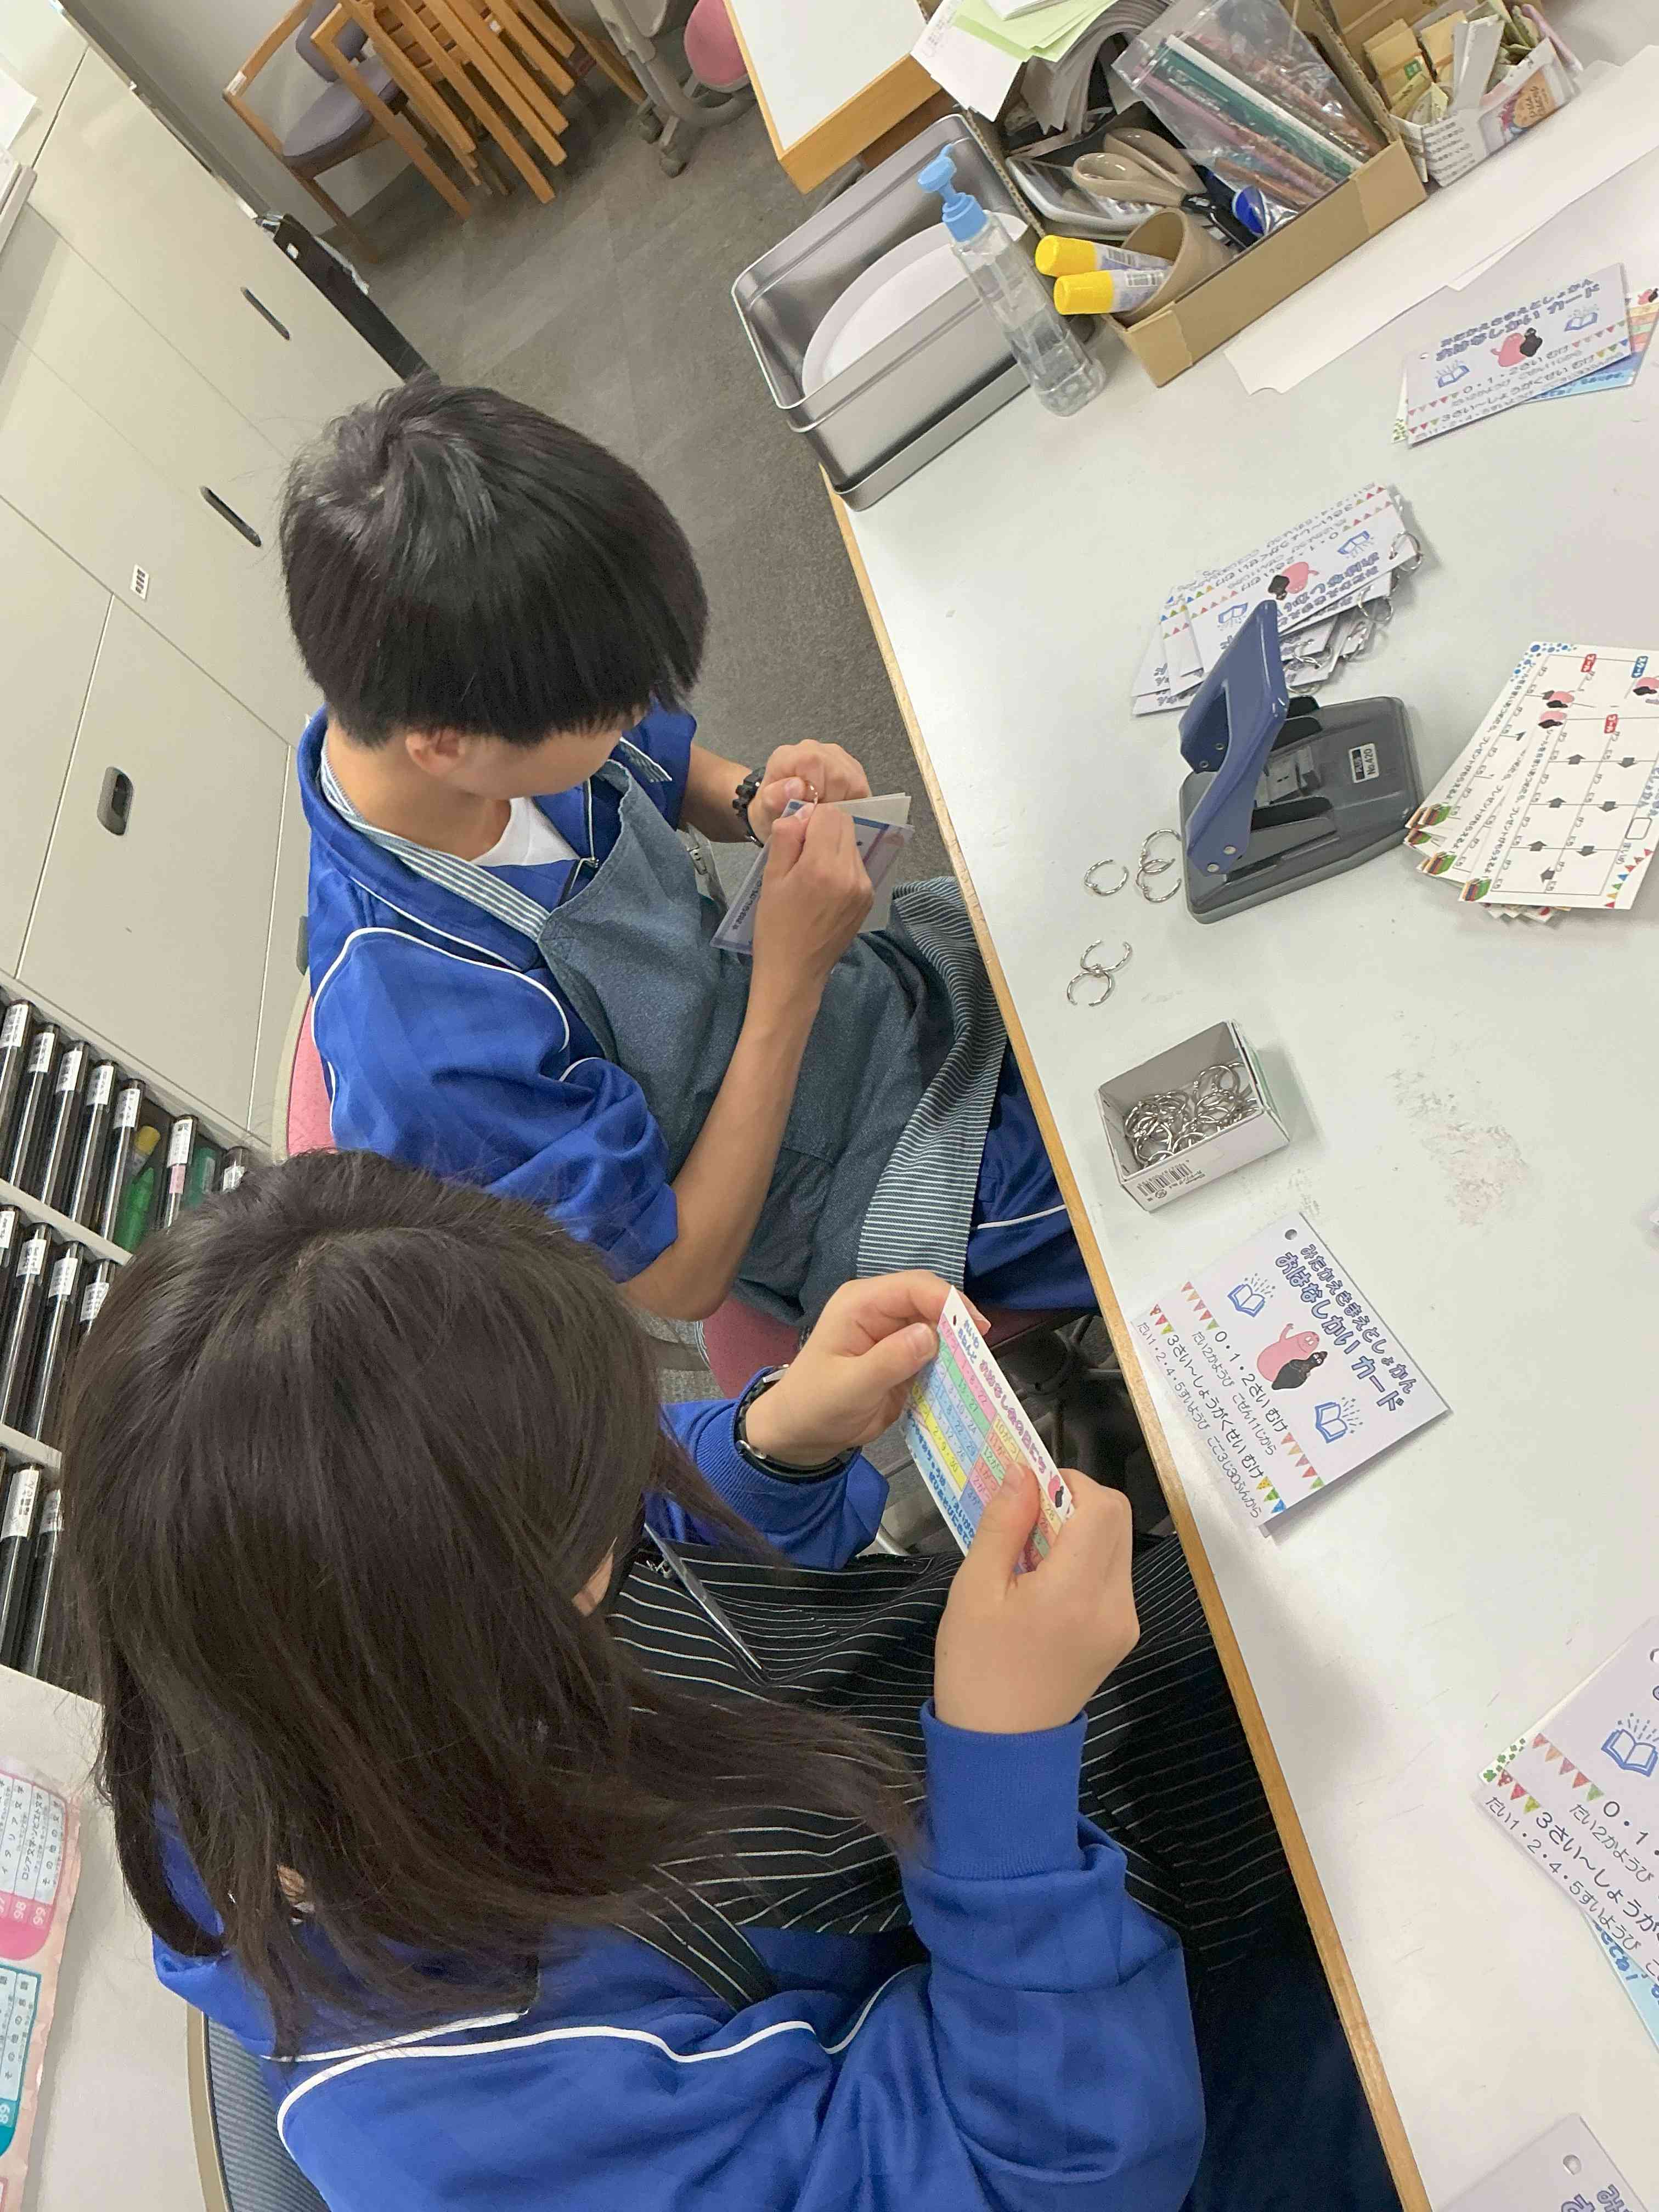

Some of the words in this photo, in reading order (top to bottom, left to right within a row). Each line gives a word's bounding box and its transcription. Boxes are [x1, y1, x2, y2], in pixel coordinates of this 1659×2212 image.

[1548, 284, 1601, 315] カード
[1364, 748, 1376, 775] No.420
[1275, 1252, 1359, 1355] おはなしかい
[1351, 1356, 1404, 1413] カード
[1300, 1244, 1418, 1394] みたかえきまえとしょかん
[1137, 1322, 1210, 1431] だい1・2・4・5すいようび
[1206, 1435, 1262, 1519] ごご3じ30ふんから
[1166, 1334, 1248, 1453] 3さい～しょうがくせい
[1241, 1453, 1264, 1479] むけ
[1192, 1330, 1234, 1387] だい2かようび
[1232, 1391, 1276, 1457] ごぜん11じから
[1214, 1330, 1269, 1410] 0・1・2さい
[1265, 1409, 1288, 1434] むけ
[1485, 1796, 1642, 1951] だい1・2・4・5すいようび
[1536, 1812, 1659, 1934] 3さい～しょうが
[1568, 1803, 1654, 1883] だい2かようび
[14, 1901, 26, 1919] 98
[32, 1906, 46, 1926] 99
